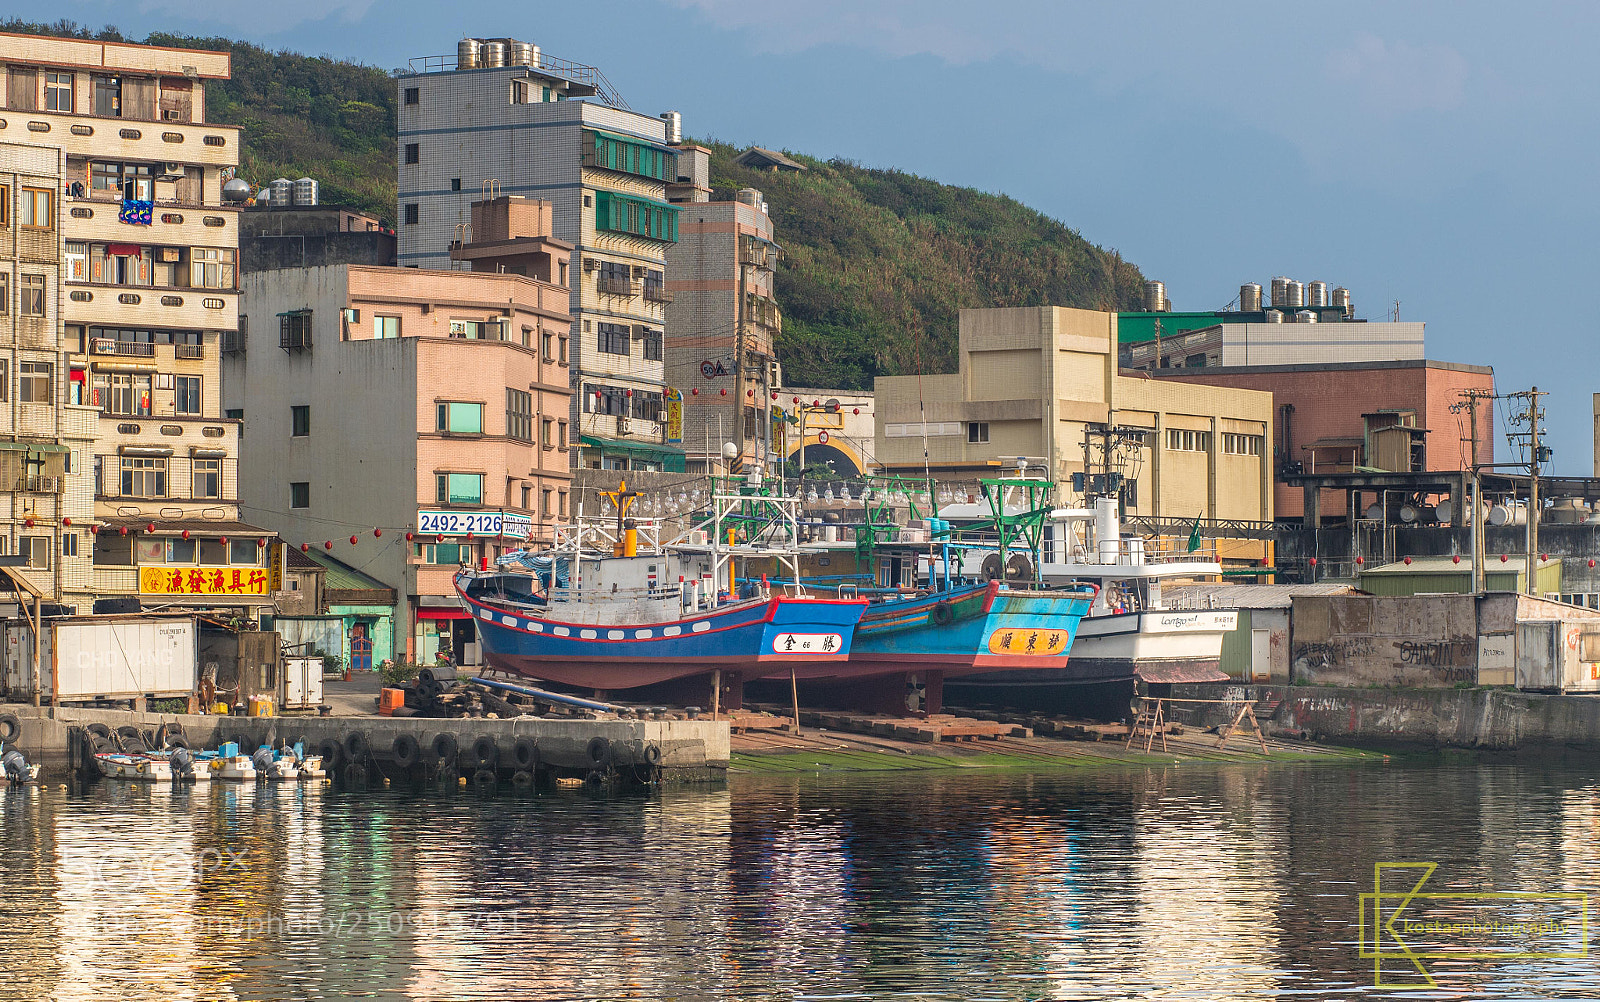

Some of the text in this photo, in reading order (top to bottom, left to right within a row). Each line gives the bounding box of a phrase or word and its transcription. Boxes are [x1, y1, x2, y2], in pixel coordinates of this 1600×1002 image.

[703, 366, 714, 374] 50
[420, 515, 502, 532] 2492-2126
[166, 568, 267, 594] 漁發漁具行
